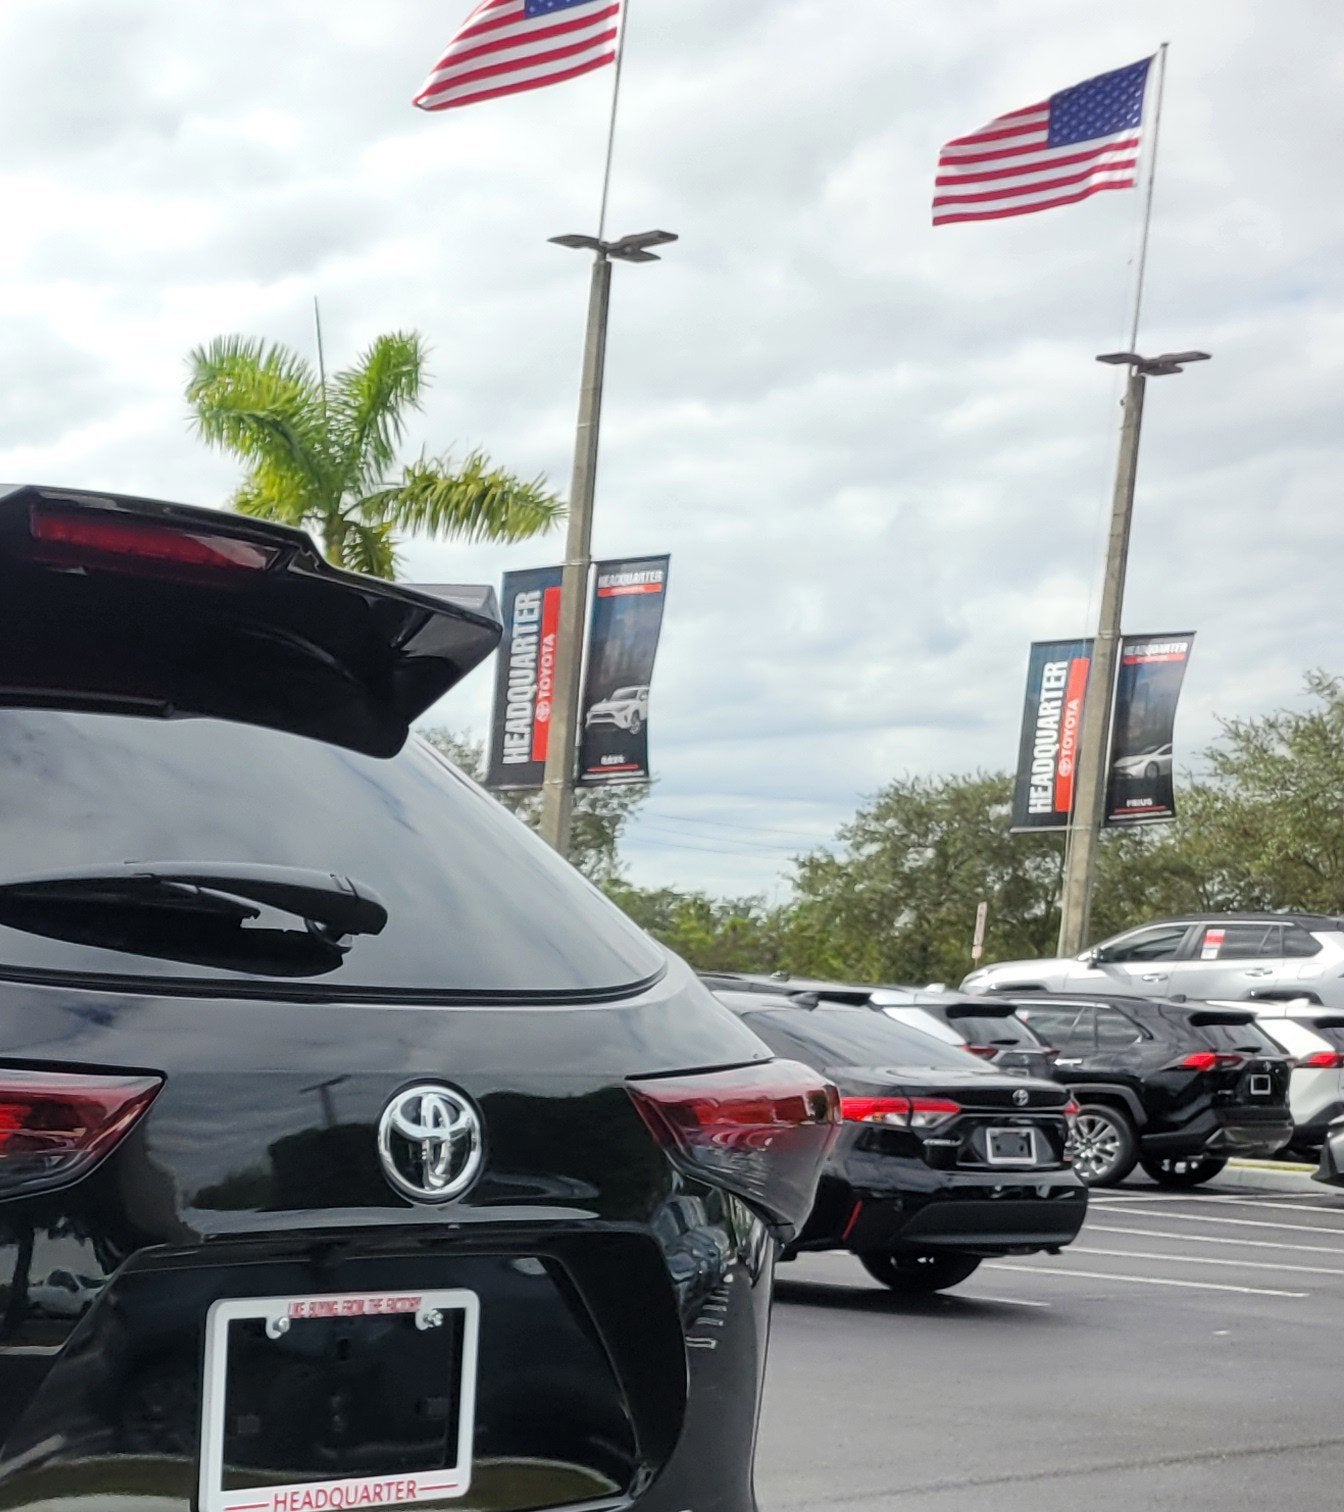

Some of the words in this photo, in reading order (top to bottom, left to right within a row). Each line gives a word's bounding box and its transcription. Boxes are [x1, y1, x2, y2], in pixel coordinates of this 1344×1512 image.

[502, 589, 542, 765] HEADQUARTER
[538, 633, 556, 699] TOYOTA
[1028, 660, 1069, 814] HEADQUARTER
[1061, 699, 1079, 755] TOYOTA
[273, 1480, 417, 1512] HEADQUARTER
